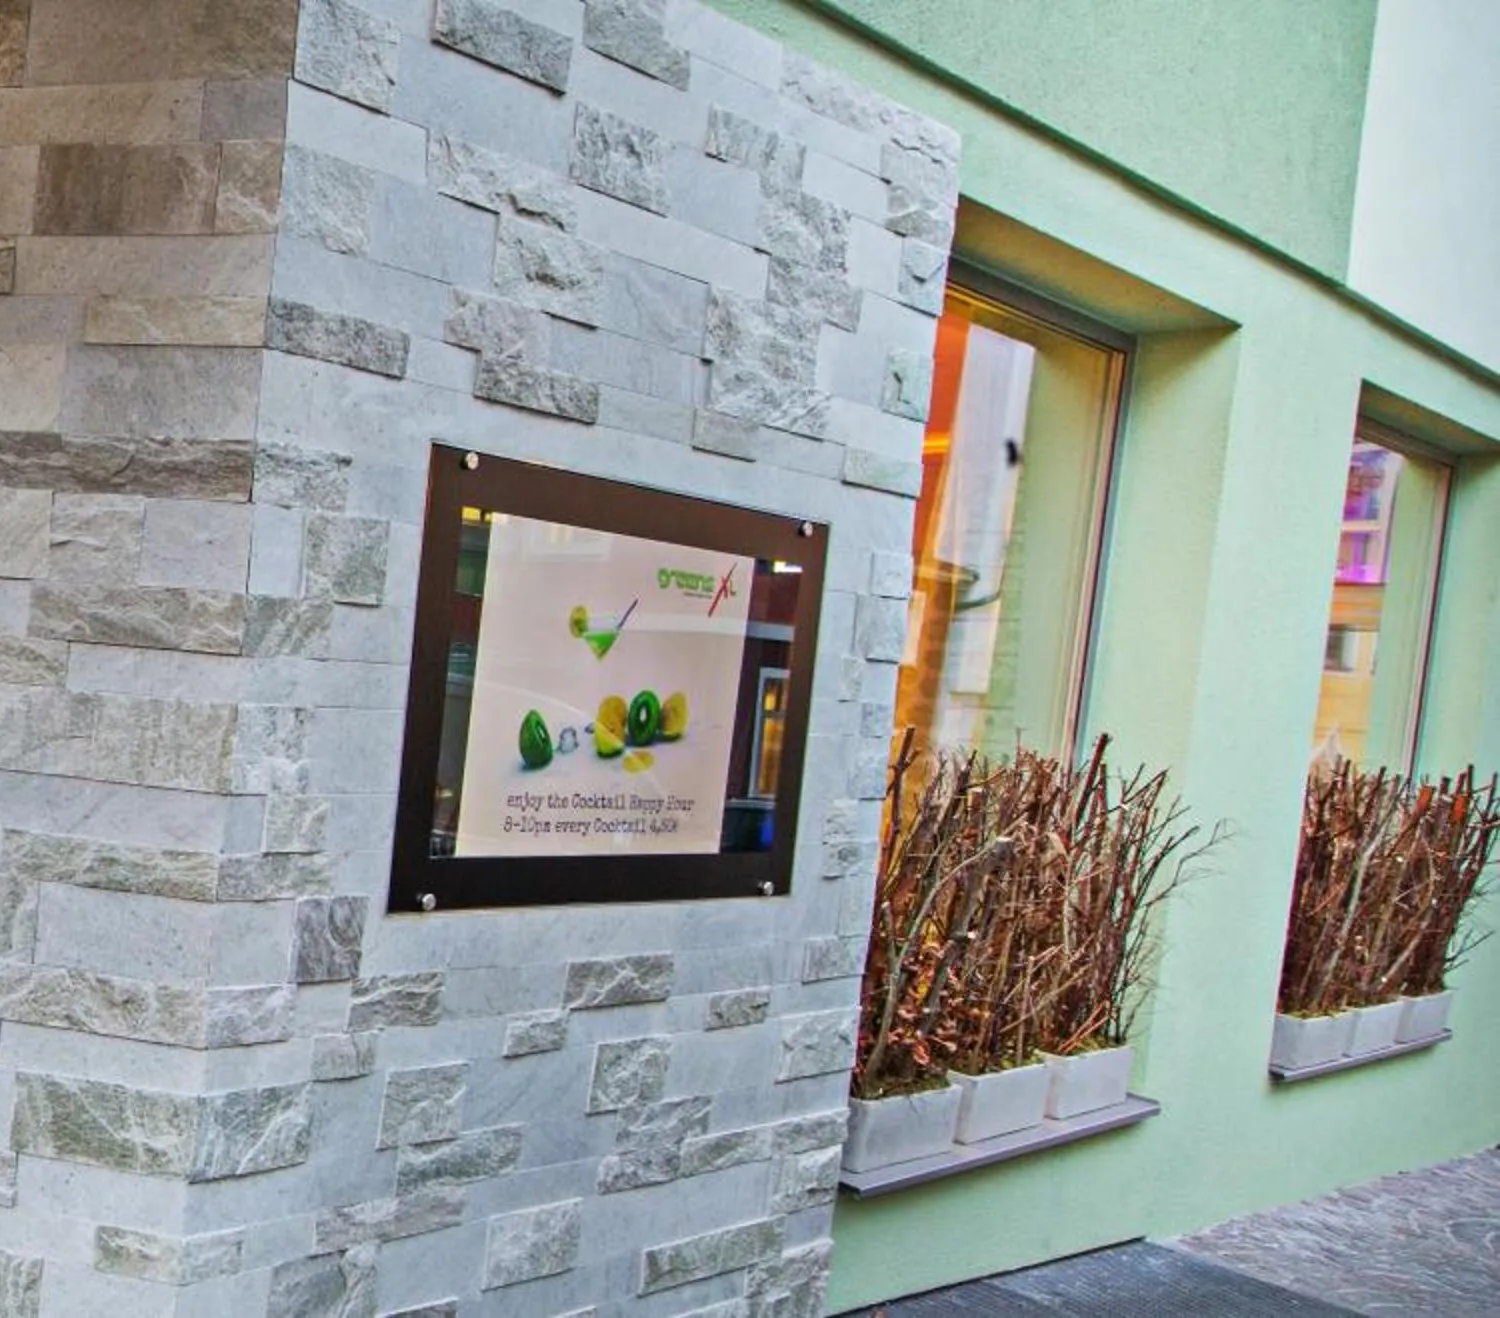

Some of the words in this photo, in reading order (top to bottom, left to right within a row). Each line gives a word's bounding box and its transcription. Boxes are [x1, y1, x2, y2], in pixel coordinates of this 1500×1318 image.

[507, 791, 545, 812] enjoy
[547, 793, 569, 809] the
[572, 793, 625, 810] Cocktail
[629, 794, 665, 814] Happy
[666, 795, 695, 811] Hour
[554, 820, 592, 837] every
[594, 817, 646, 833] Cocktail
